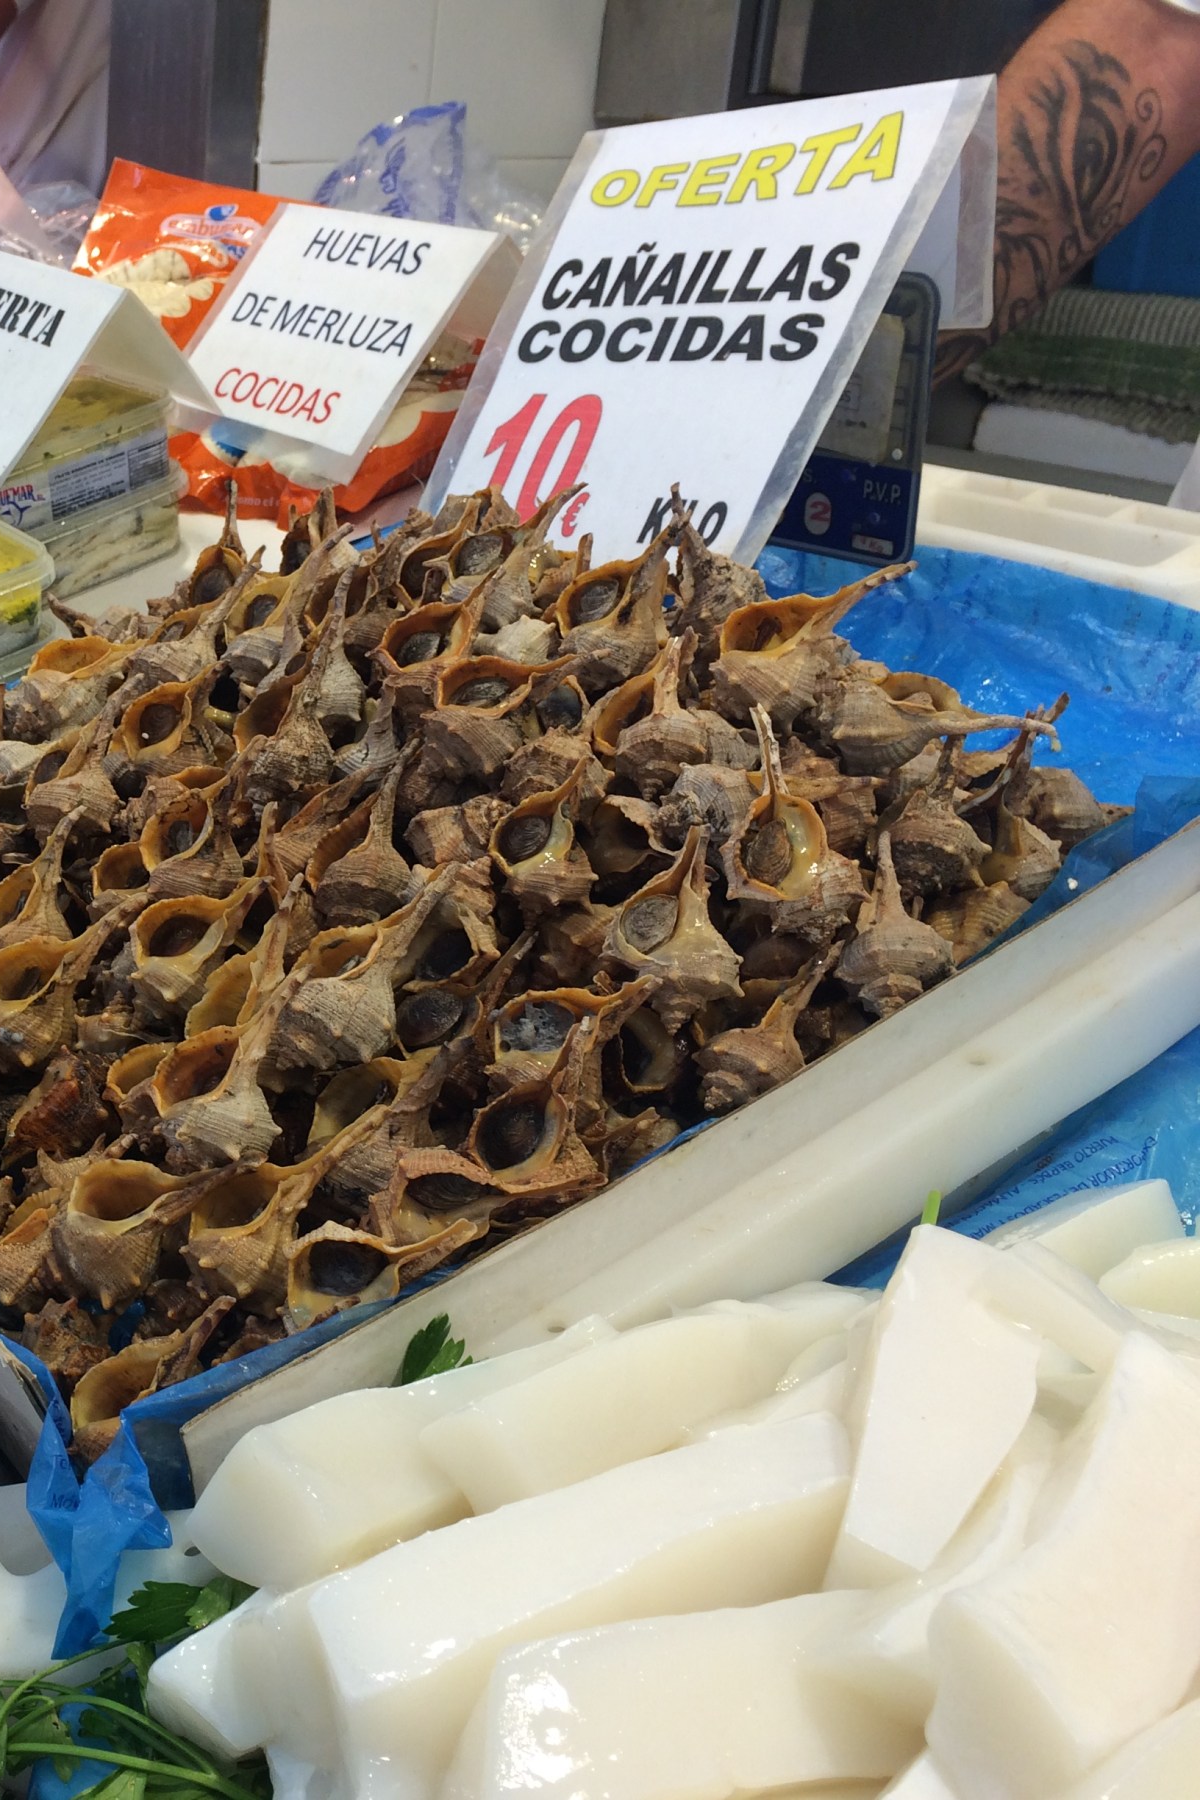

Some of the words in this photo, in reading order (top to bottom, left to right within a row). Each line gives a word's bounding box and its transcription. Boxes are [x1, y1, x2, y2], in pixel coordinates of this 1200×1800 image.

[591, 111, 904, 208] OFERTA
[303, 227, 431, 275] HUEVAS
[542, 241, 860, 310] CAÑAILLAS
[231, 292, 277, 327] DE
[271, 300, 413, 357] MERLUZA
[518, 313, 826, 363] COCIDAS
[214, 367, 341, 424] COCIDAS
[483, 393, 603, 525] 10
[561, 492, 590, 538] €
[636, 497, 728, 547] KO
[1074, 1135, 1121, 1163] PUERTO
